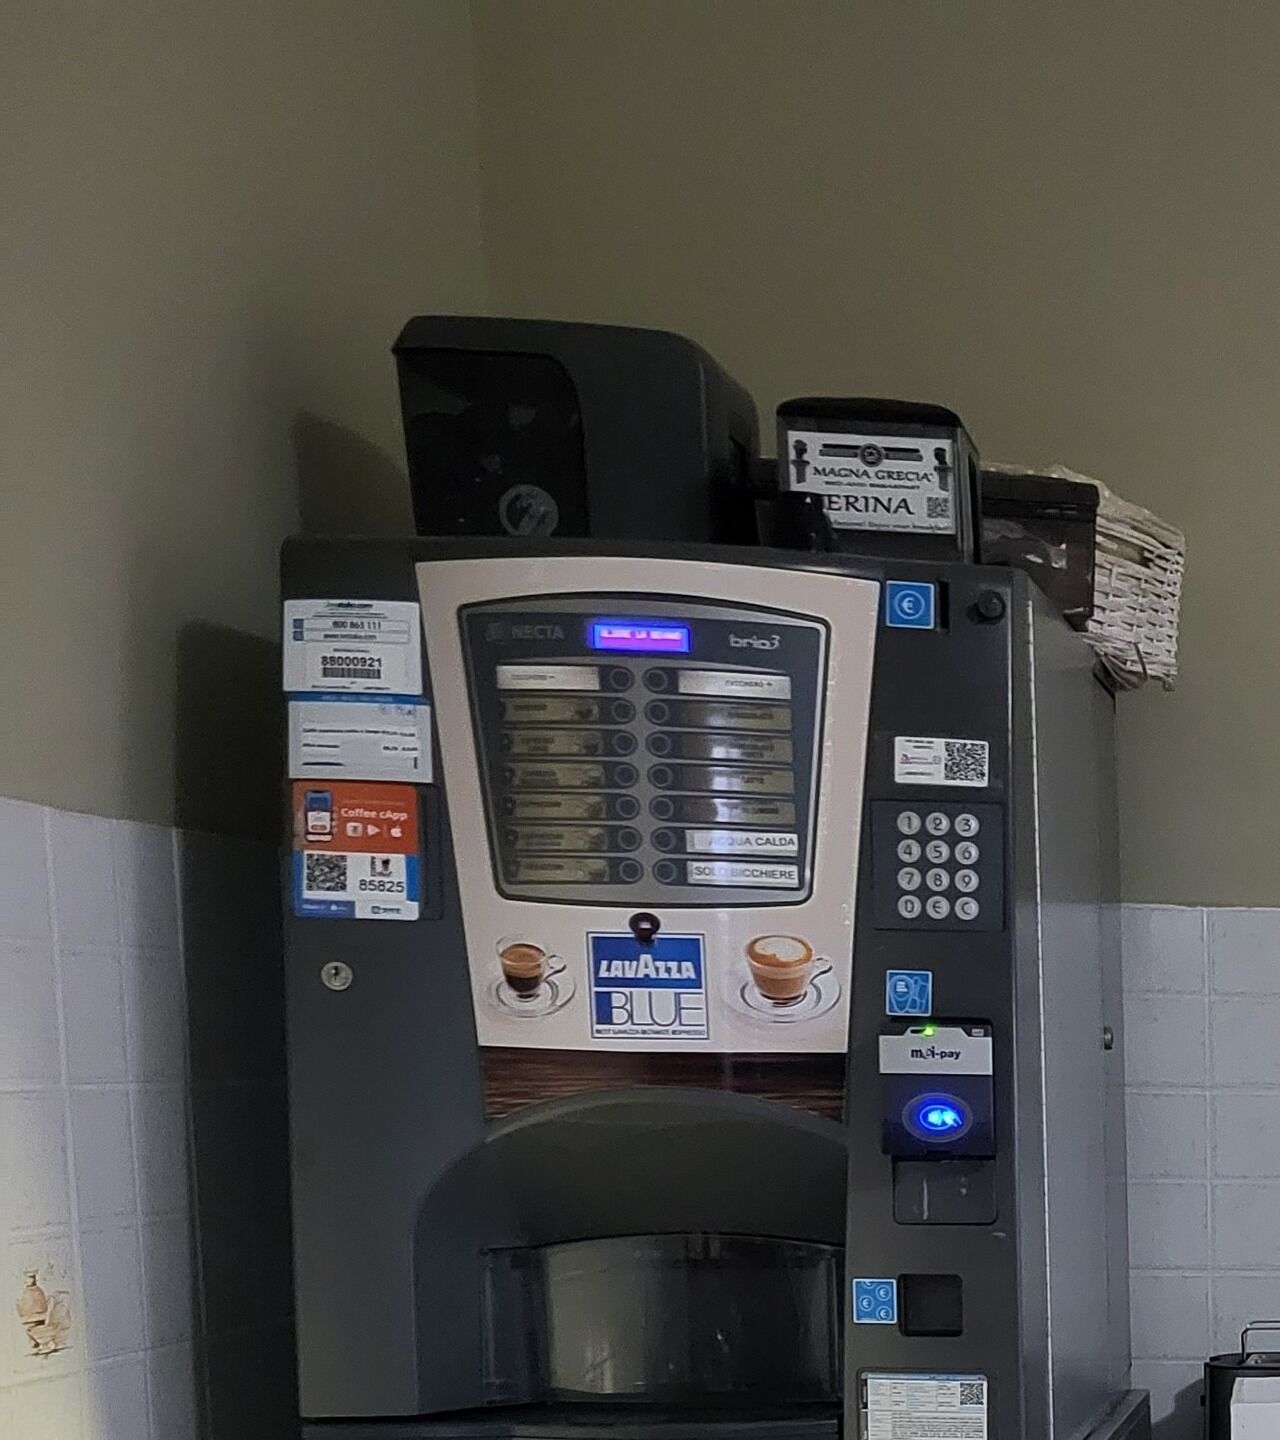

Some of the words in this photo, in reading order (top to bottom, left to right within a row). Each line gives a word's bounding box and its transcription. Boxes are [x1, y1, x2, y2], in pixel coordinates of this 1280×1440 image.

[813, 466, 871, 479] MAGNA
[875, 470, 932, 482] GRECIA
[826, 494, 915, 515] ERINA
[341, 807, 377, 819] Coffee
[379, 809, 408, 821] cApp
[906, 816, 912, 829] 1
[933, 816, 943, 831] 2
[962, 818, 972, 832] 3
[755, 837, 796, 847] CALDA
[903, 844, 912, 856] 4
[933, 845, 943, 859] 5
[962, 846, 972, 860] 6
[904, 872, 914, 885] 7
[933, 873, 943, 887] 8
[962, 874, 972, 888] 9
[359, 879, 405, 893] 85825
[904, 899, 915, 913] 0
[932, 900, 942, 914] E
[961, 901, 971, 915] C
[599, 954, 697, 979] LAVAZZA
[594, 991, 706, 1026] BLUE
